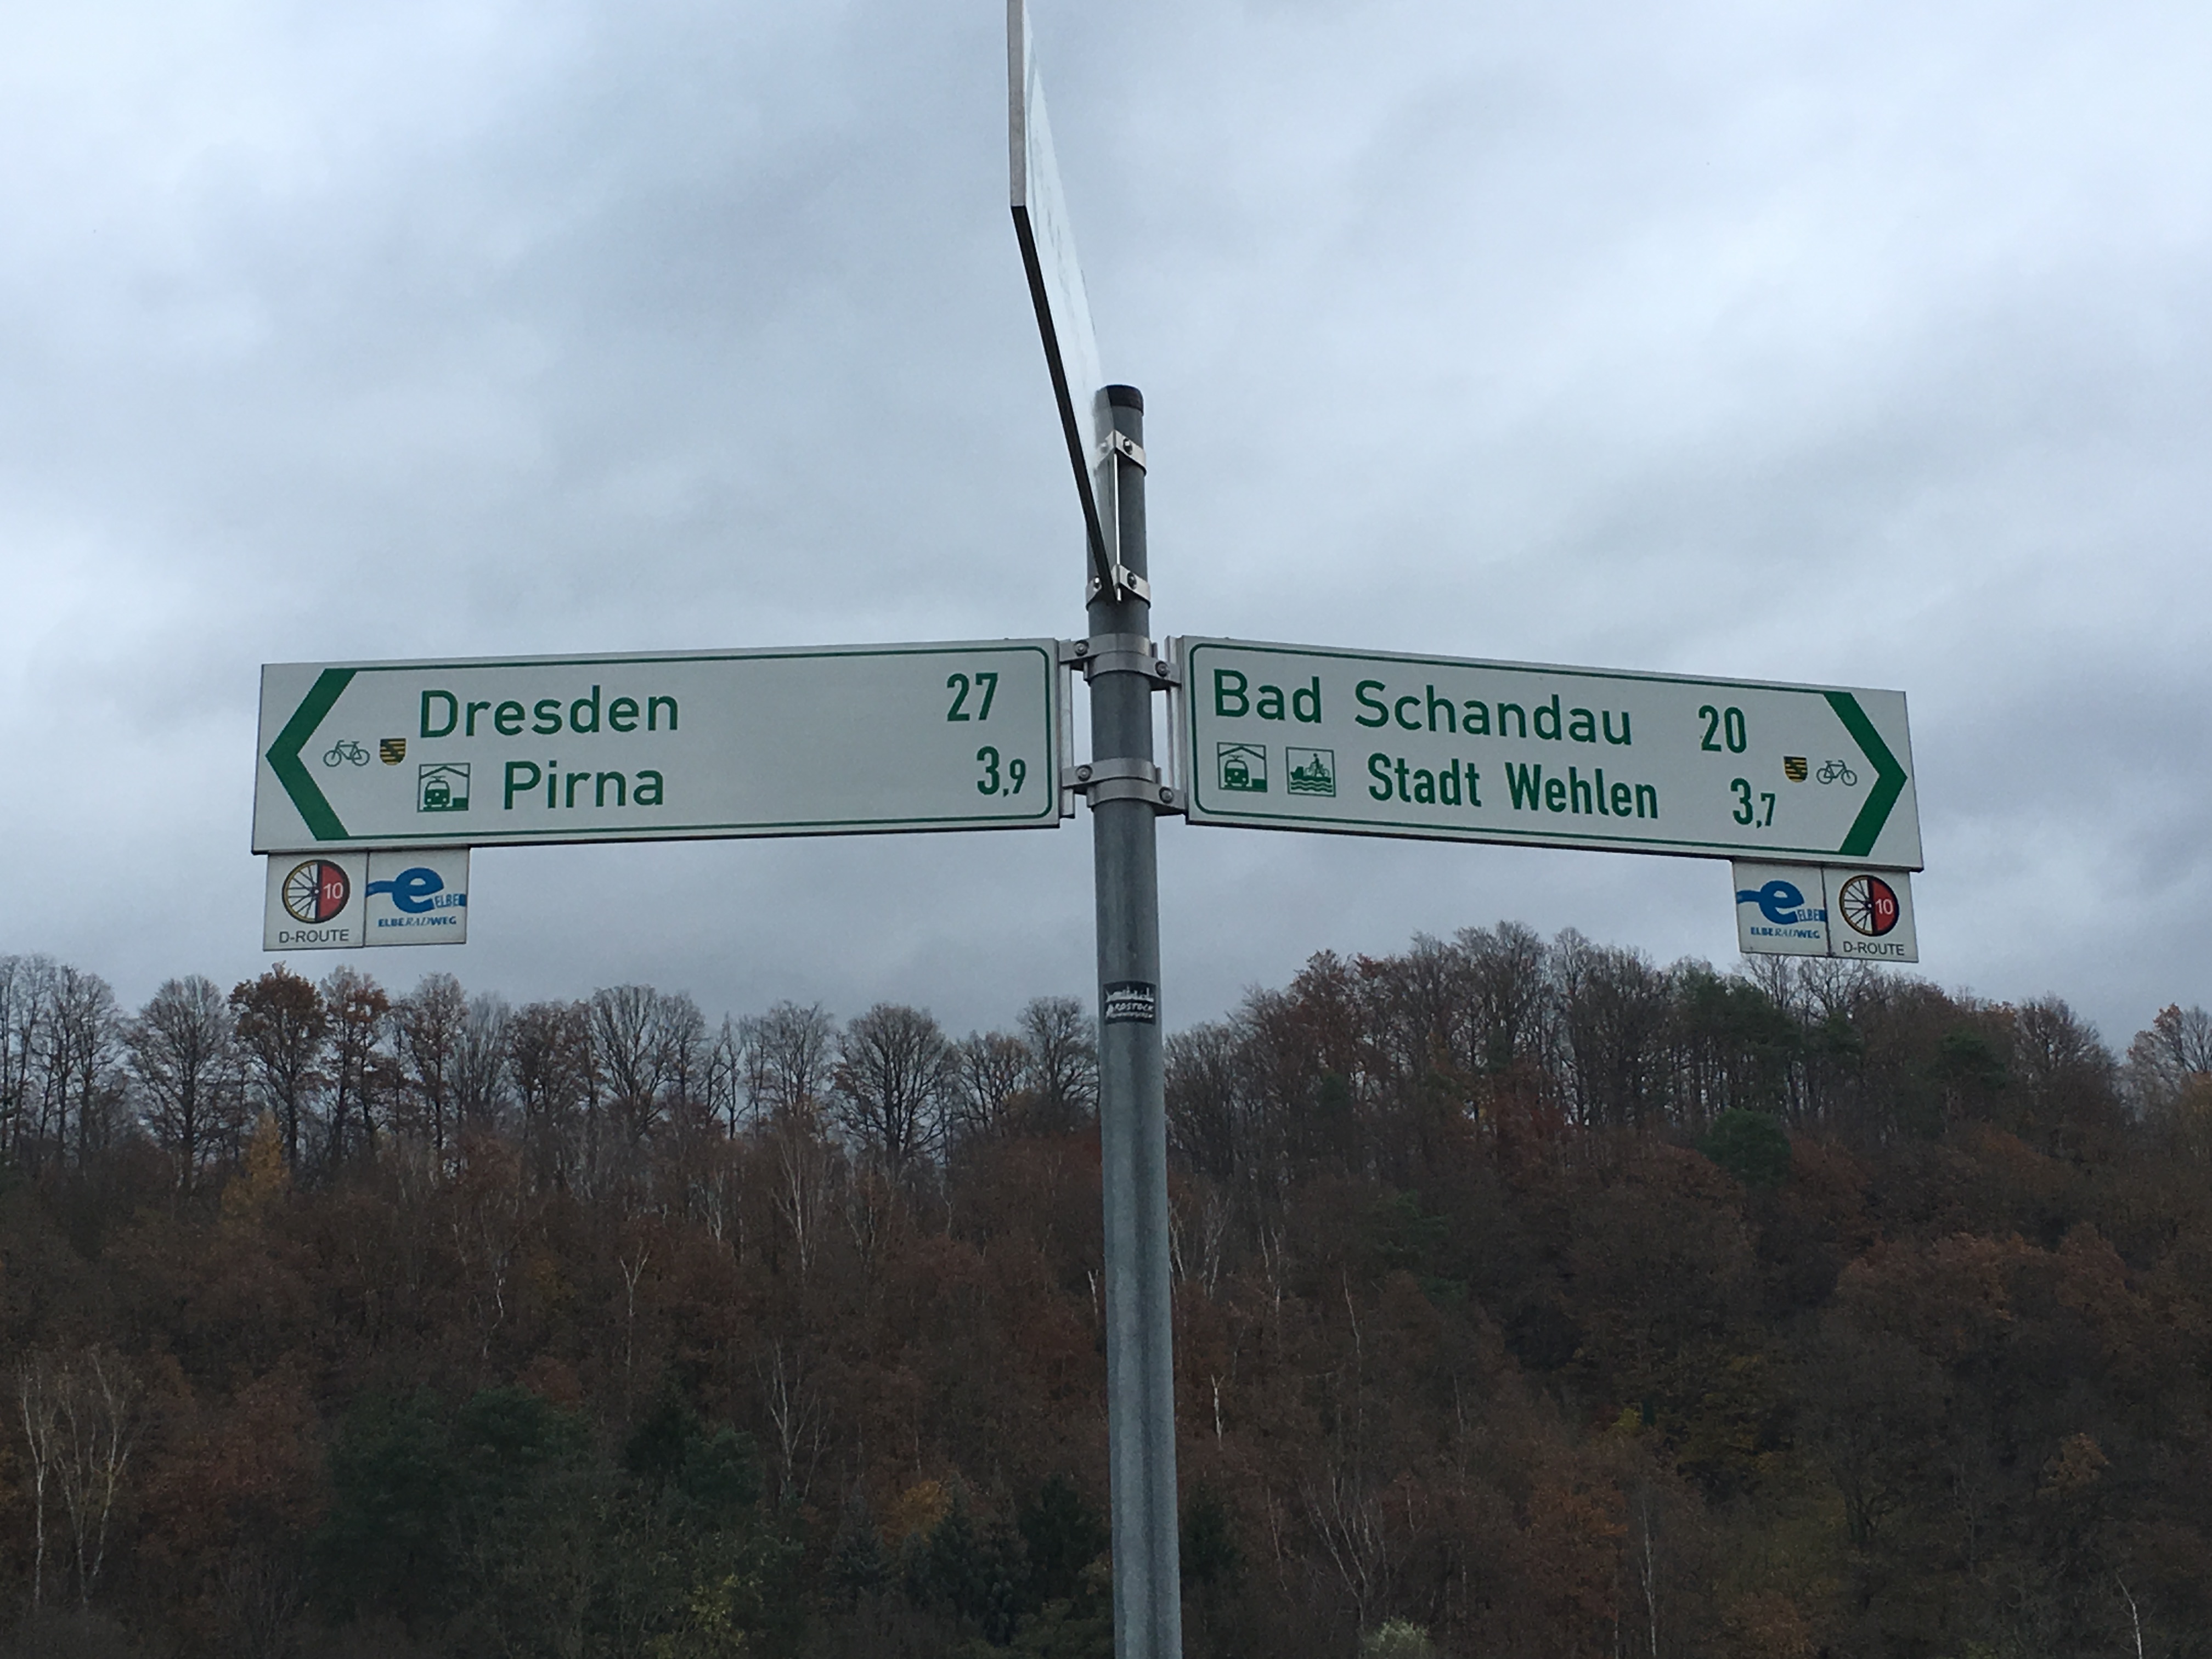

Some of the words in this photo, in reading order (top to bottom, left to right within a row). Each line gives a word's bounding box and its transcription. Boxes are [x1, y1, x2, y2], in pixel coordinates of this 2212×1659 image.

[420, 685, 678, 738] Dresden
[946, 672, 998, 722] 27
[1214, 668, 1322, 724] Bad
[1354, 679, 1632, 746] Schandau
[1698, 705, 1747, 754] 20
[504, 760, 664, 810] Pirna
[976, 746, 1026, 797] 3,9
[1367, 753, 1482, 807] Stadt
[1505, 762, 1658, 819] Wehlen
[1730, 777, 1776, 829] 3,7
[323, 882, 343, 900] 10
[435, 894, 460, 907] ELBE
[1875, 898, 1893, 915] 10
[377, 916, 457, 928] ELBERADWEG
[1797, 909, 1820, 922] ELBE
[278, 929, 349, 944] D-ROUTE
[1750, 926, 1821, 939] ELBERADWEG
[1843, 941, 1905, 956] D-ROUTE
